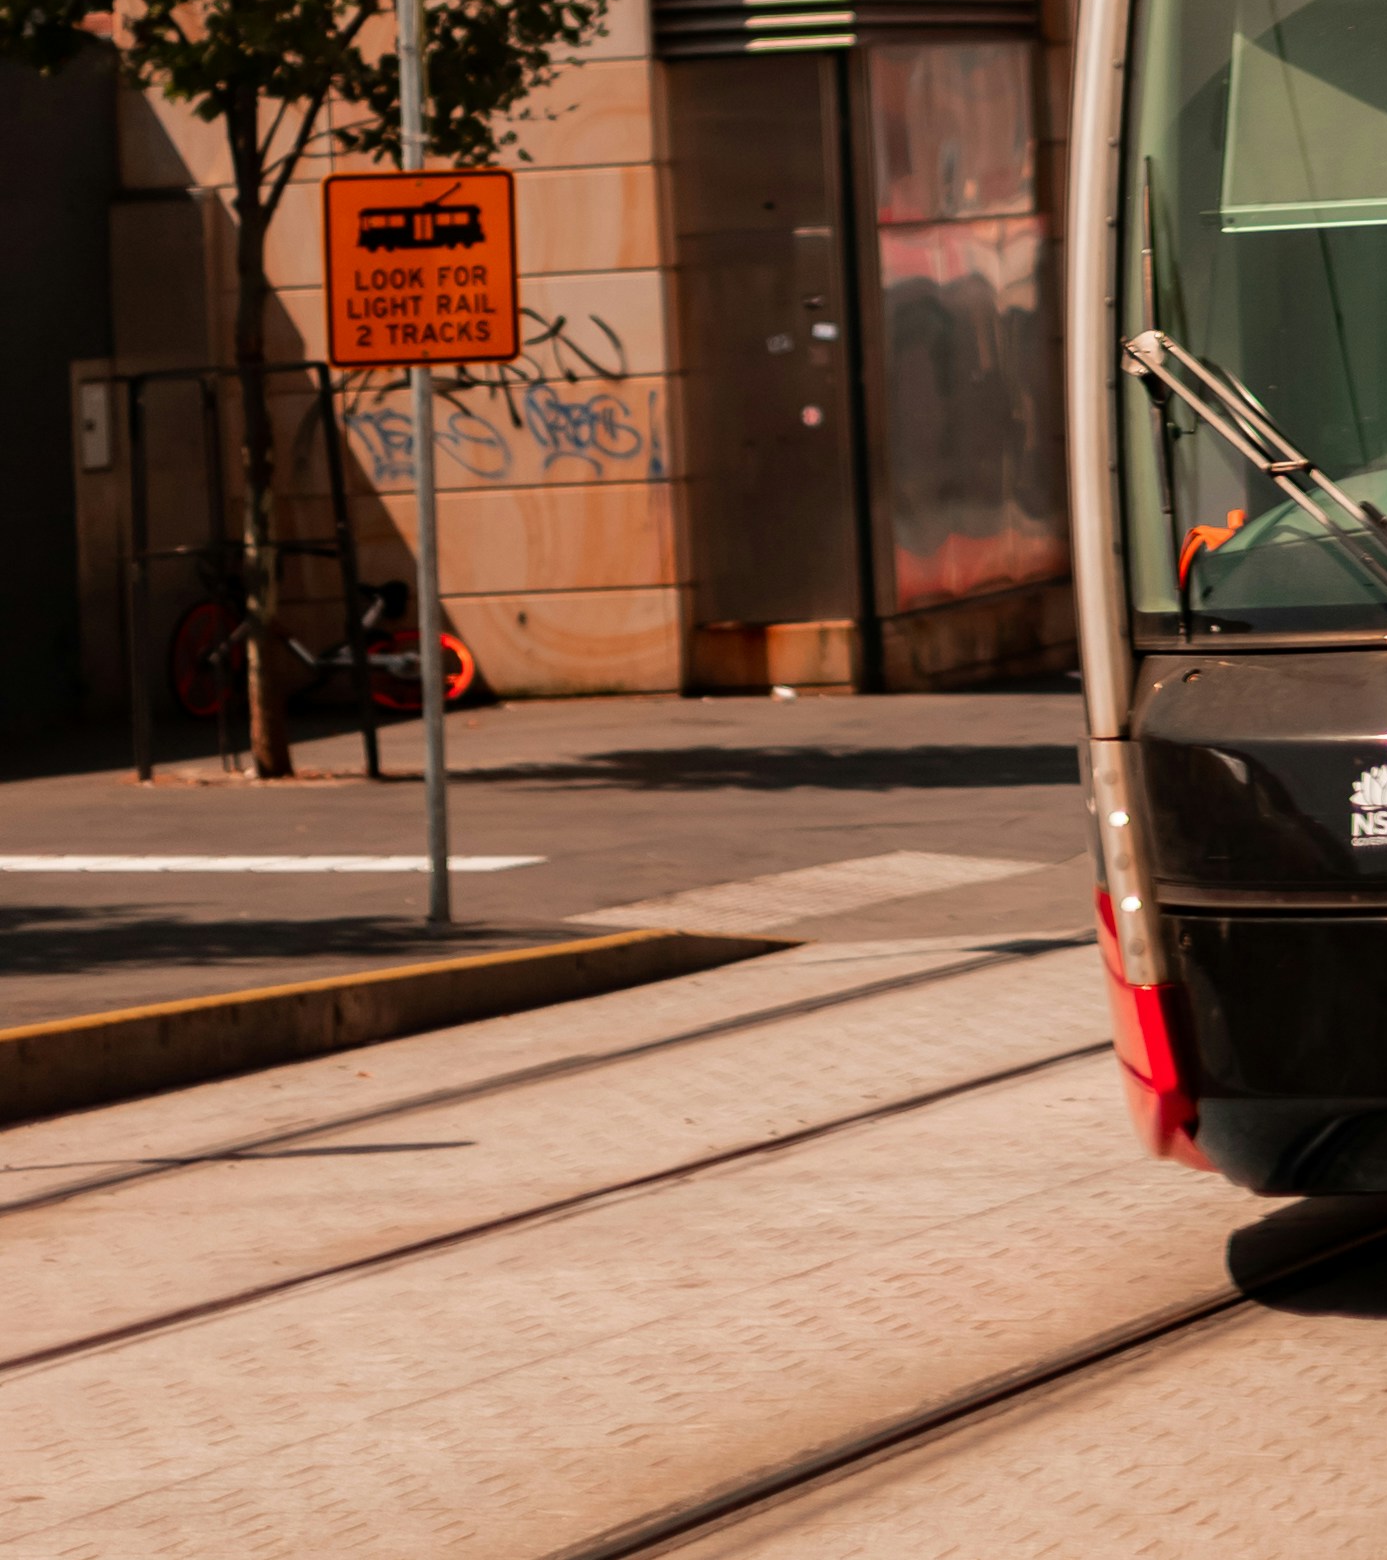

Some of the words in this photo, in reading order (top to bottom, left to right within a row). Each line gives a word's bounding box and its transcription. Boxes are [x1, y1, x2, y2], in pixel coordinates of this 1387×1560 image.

[354, 268, 424, 291] LOOK
[437, 265, 487, 287] FOR
[346, 296, 422, 319] LIGHT
[436, 293, 496, 314] RAIL
[356, 325, 372, 347] 2
[386, 320, 491, 346] TRACKS
